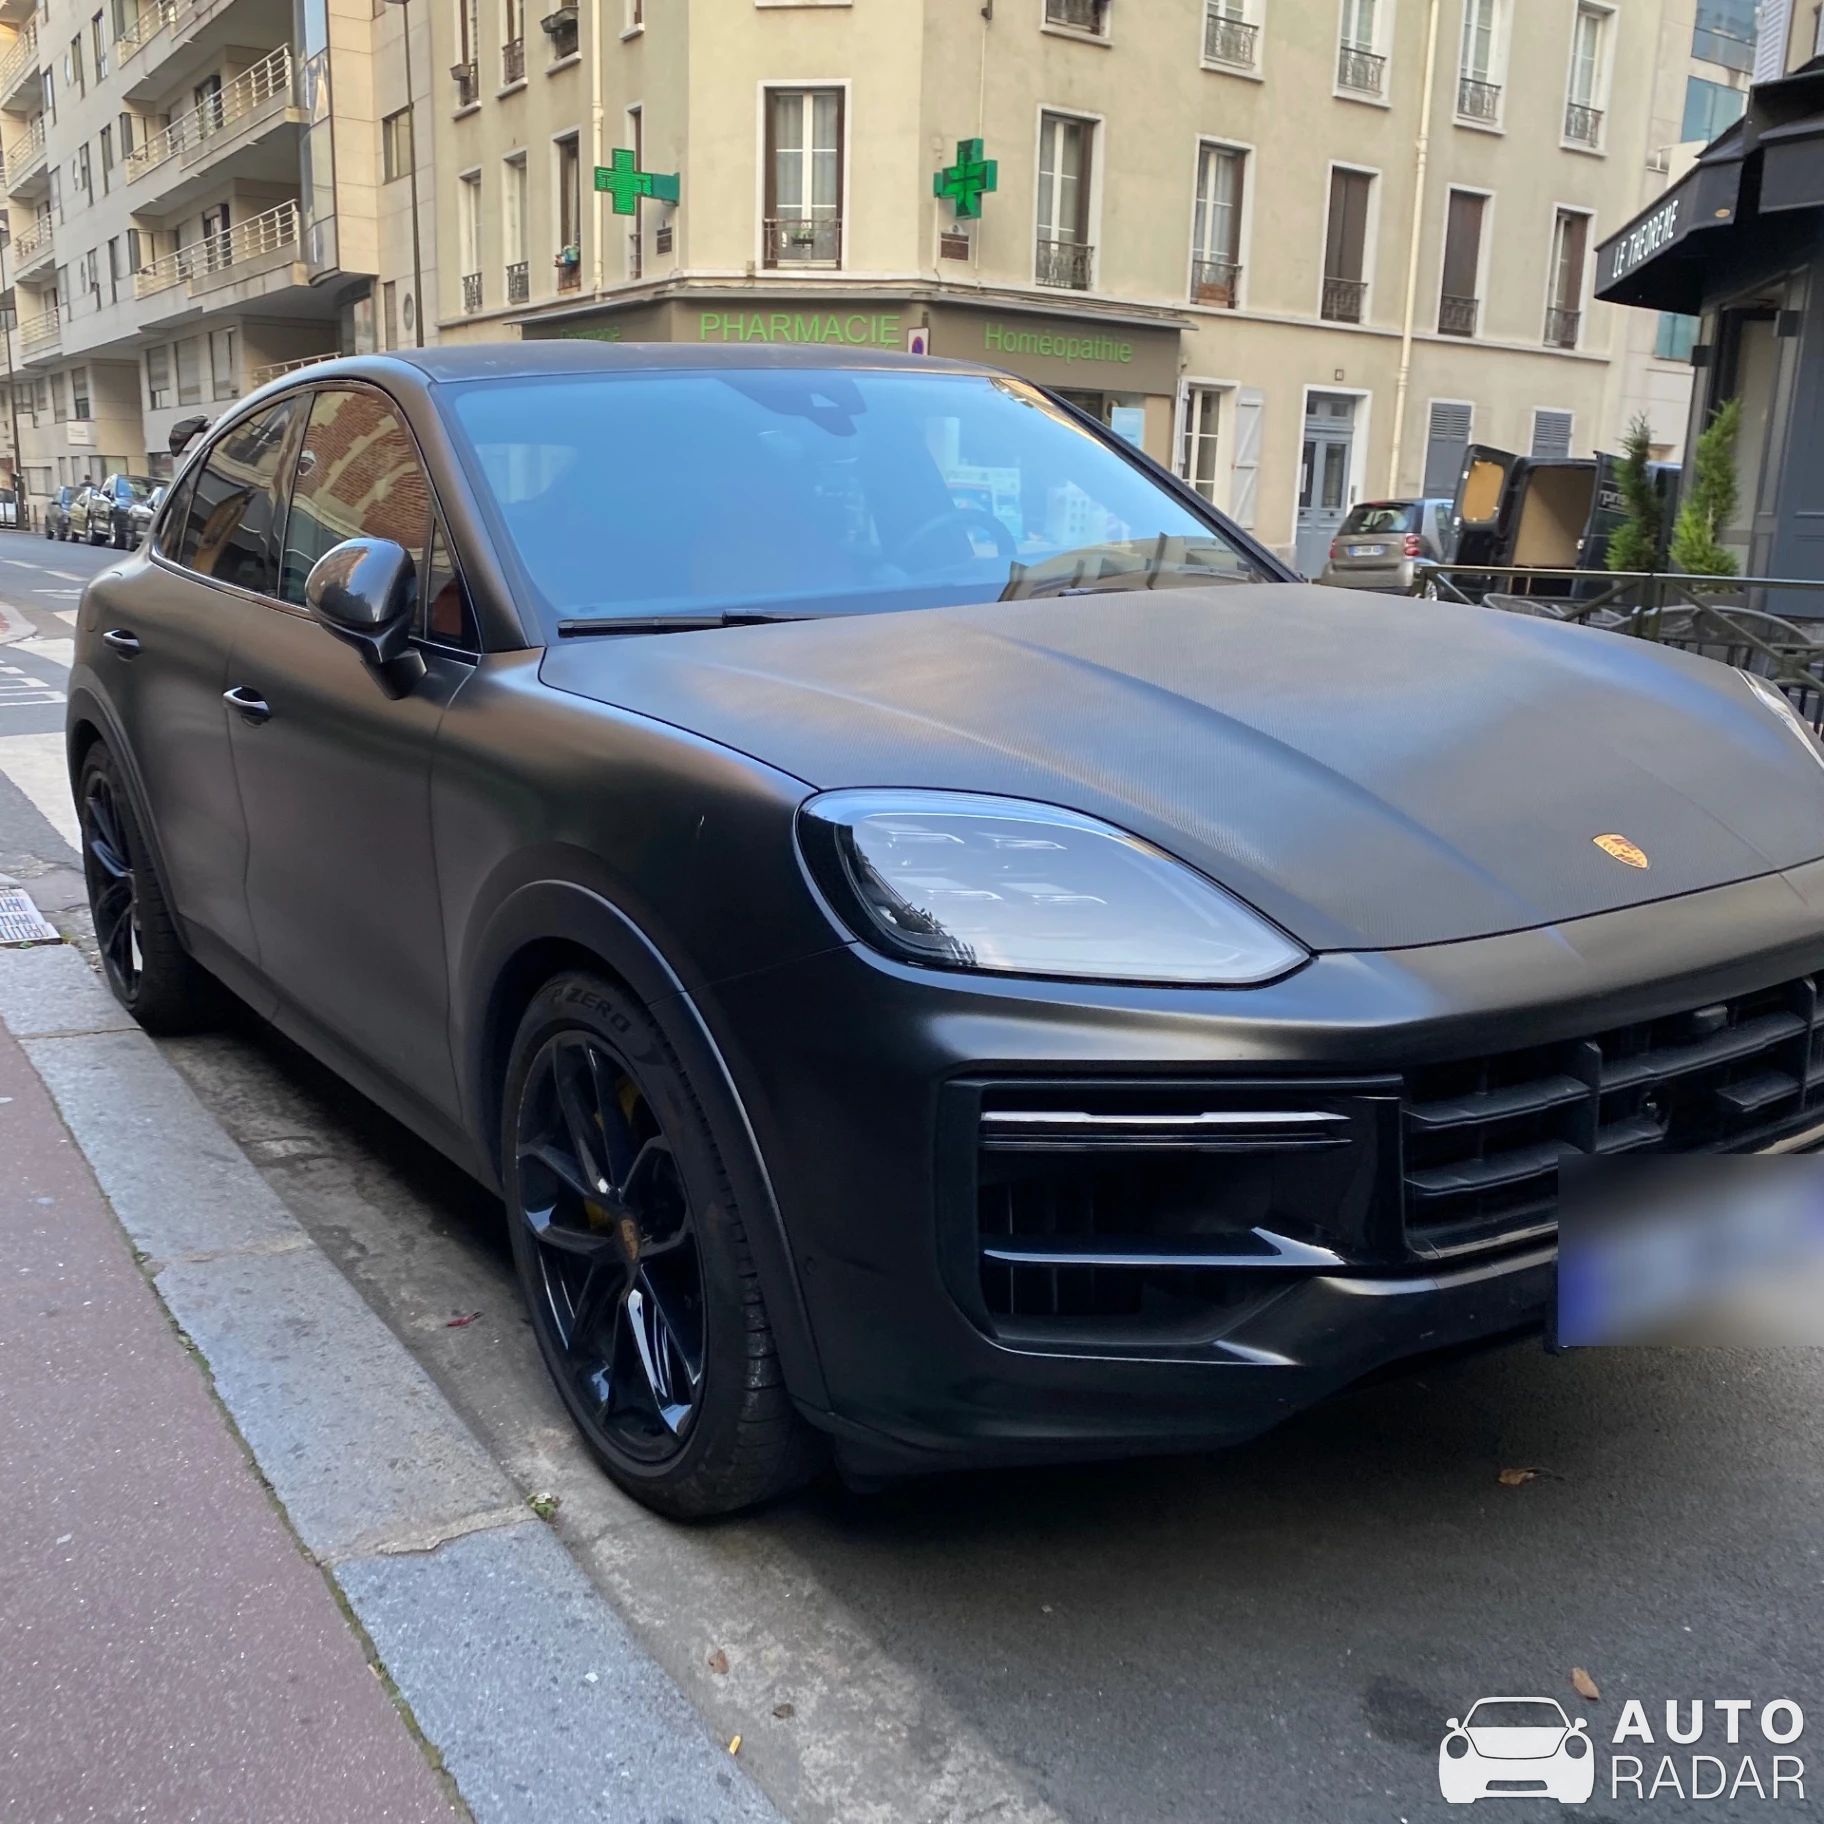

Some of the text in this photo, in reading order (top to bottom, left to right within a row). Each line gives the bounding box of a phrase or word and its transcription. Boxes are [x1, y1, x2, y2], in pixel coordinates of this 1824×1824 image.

[700, 312, 901, 344] PHARMACIE
[984, 321, 1133, 365] Homéopathie
[565, 986, 632, 1034] ZERO
